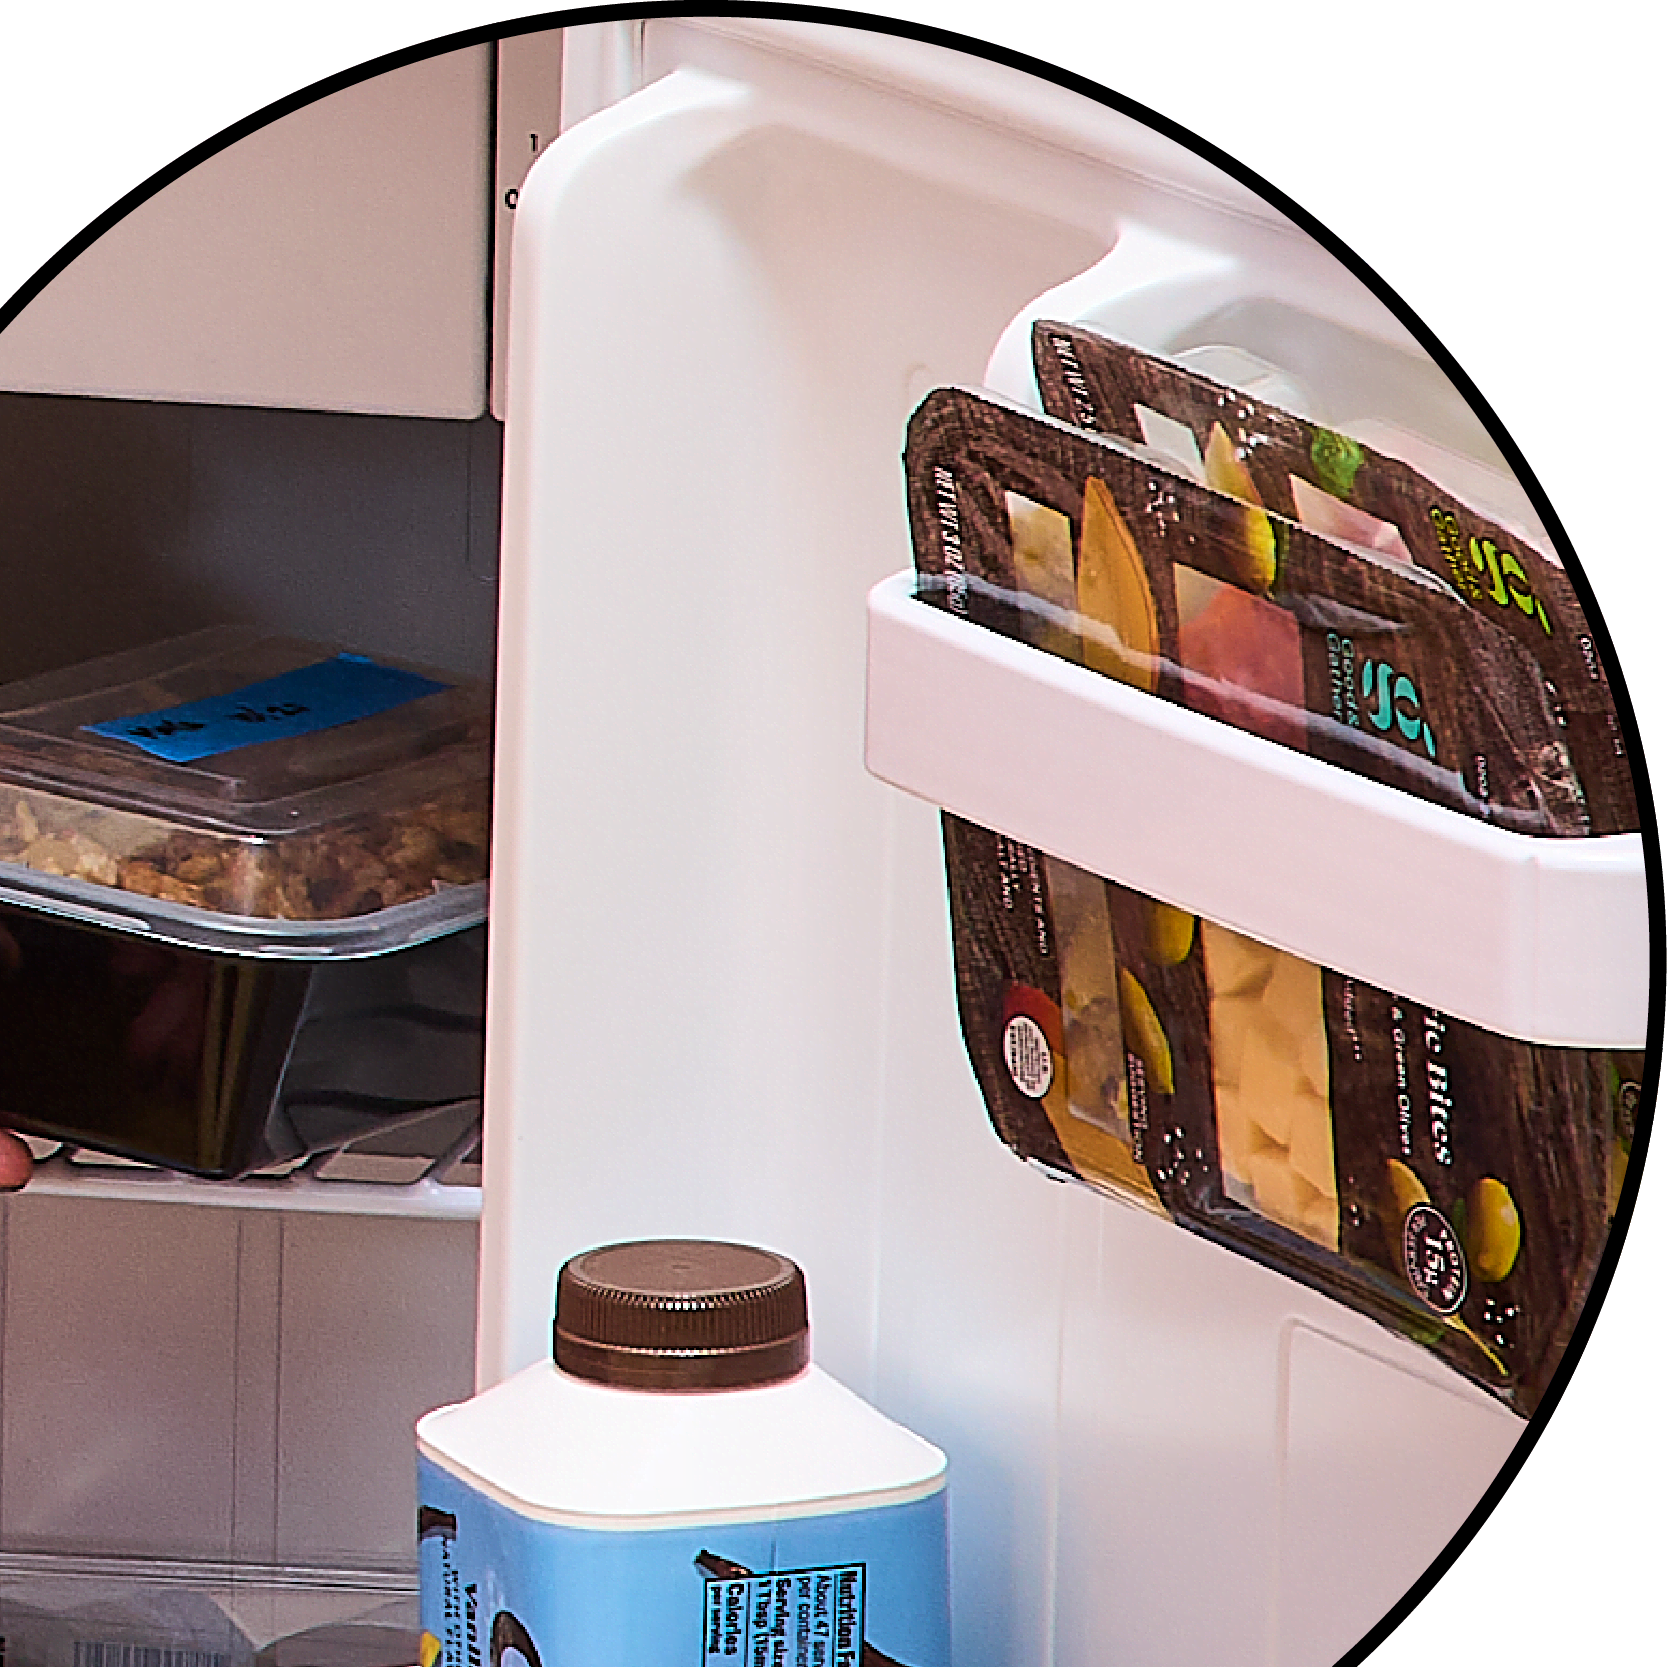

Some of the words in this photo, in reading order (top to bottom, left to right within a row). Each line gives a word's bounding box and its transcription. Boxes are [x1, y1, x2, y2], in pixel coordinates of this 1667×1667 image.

[1426, 1060, 1453, 1165] Bites
[724, 1584, 744, 1655] Calories
[838, 1571, 857, 1649] Nutrition
